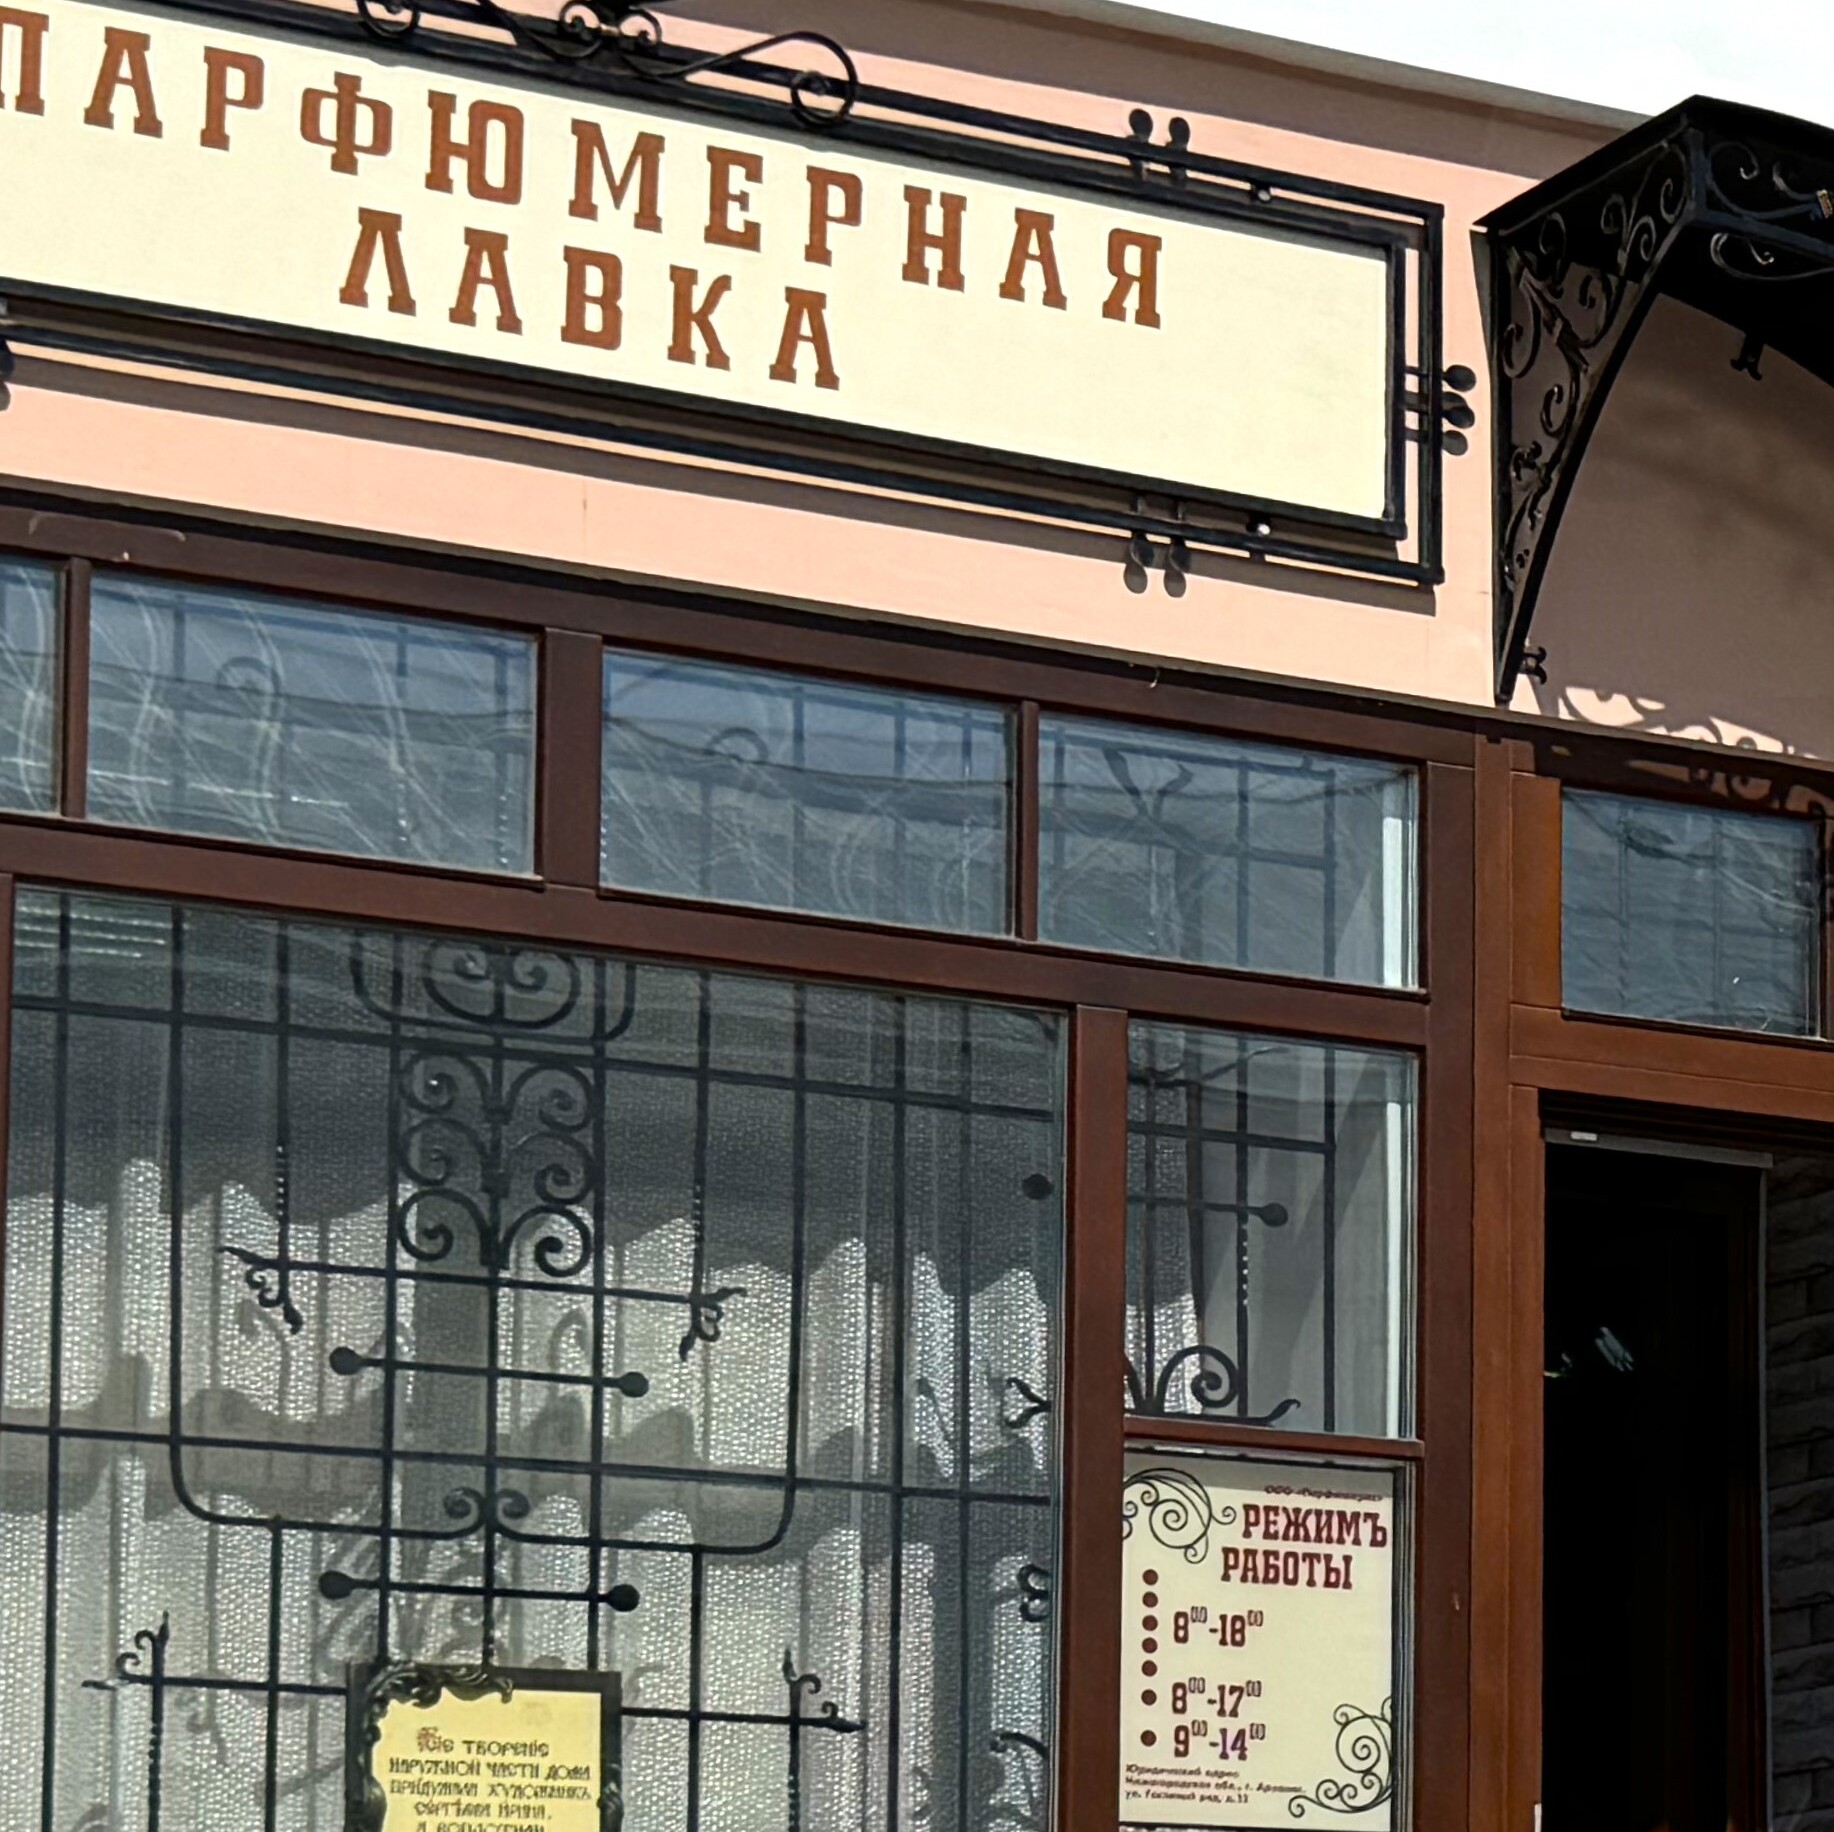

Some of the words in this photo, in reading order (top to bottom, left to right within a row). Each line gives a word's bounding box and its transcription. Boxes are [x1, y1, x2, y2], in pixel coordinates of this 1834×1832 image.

[0, 5, 1163, 330] ПАРФЮМЕРНАЯ
[338, 206, 840, 391] ЛАВКА
[1220, 1546, 1354, 1590] РАБОТЫ
[1241, 1502, 1388, 1549] РЕЖИМЪ
